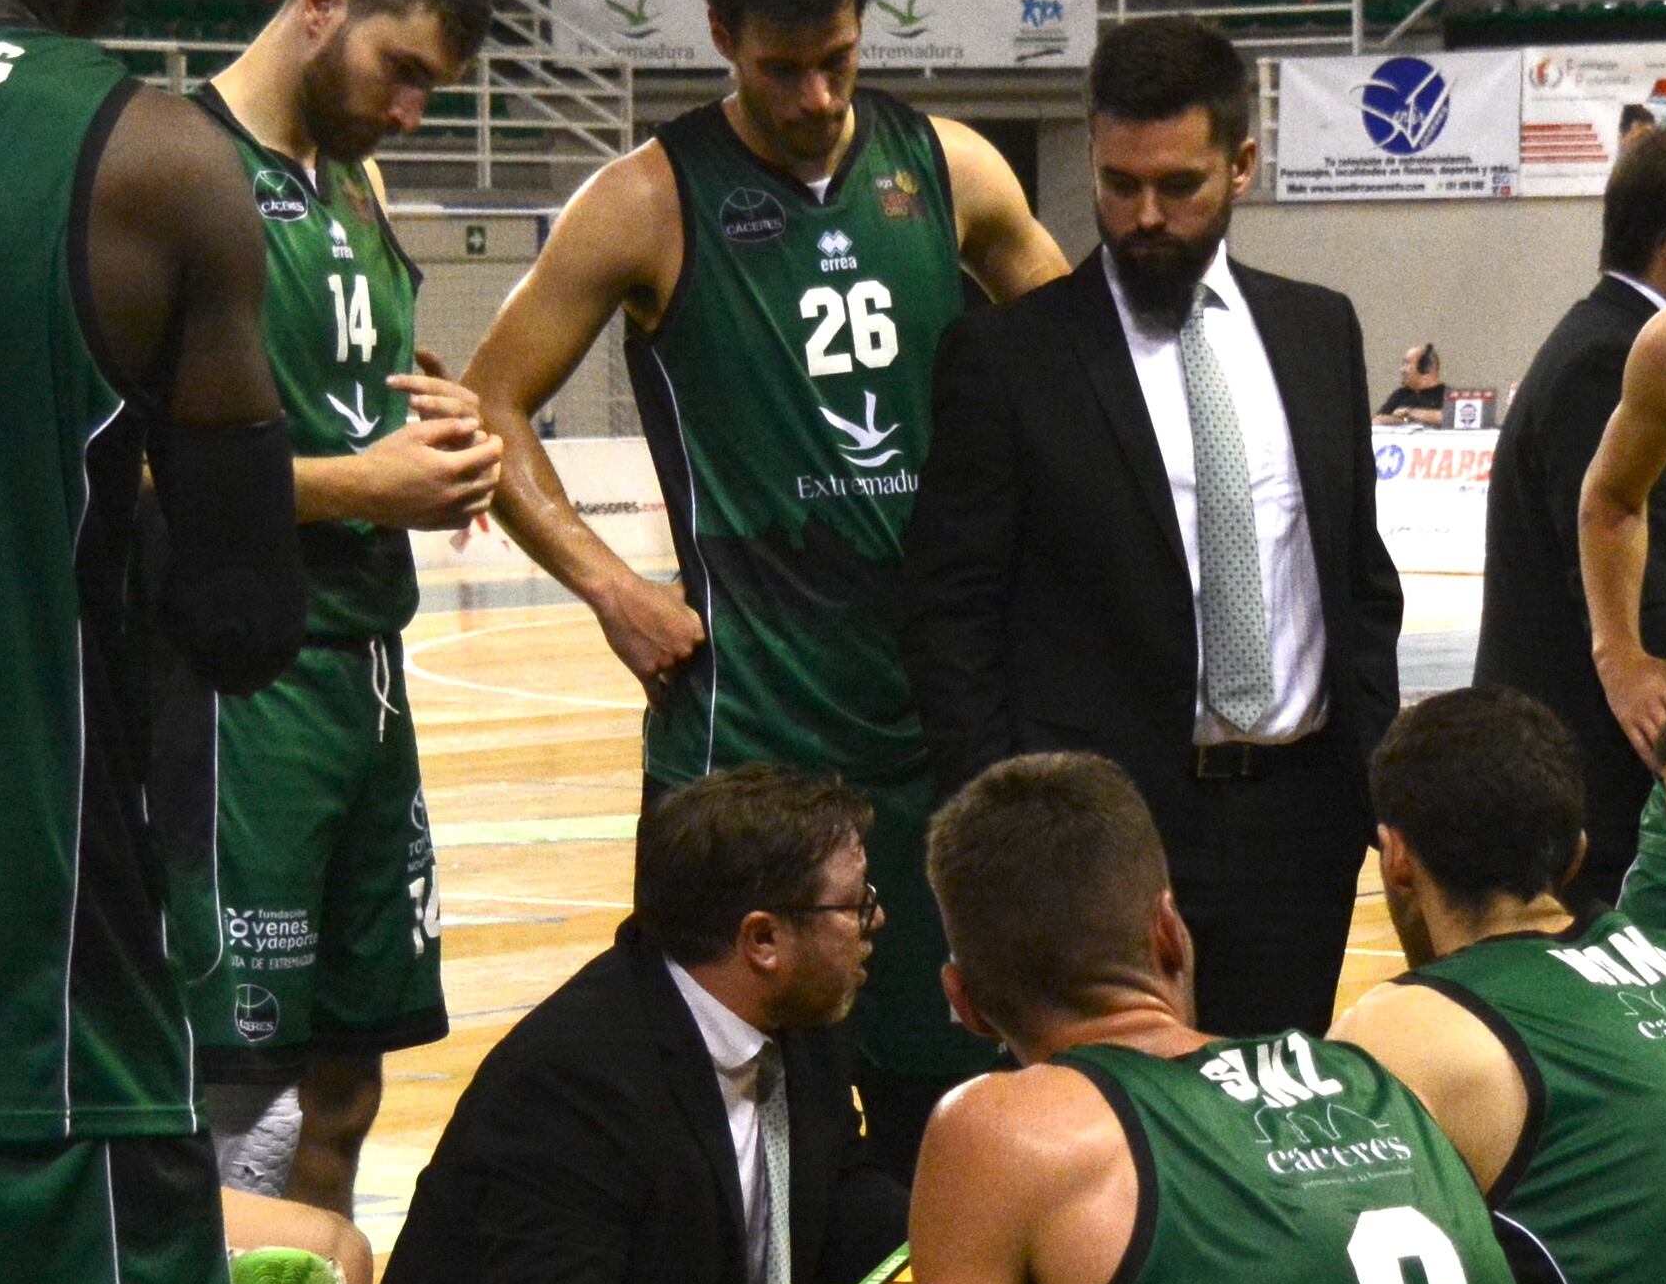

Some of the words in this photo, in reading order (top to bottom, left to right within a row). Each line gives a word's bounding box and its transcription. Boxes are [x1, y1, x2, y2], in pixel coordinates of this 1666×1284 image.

[820, 255, 858, 273] errea
[327, 273, 378, 363] 14
[800, 280, 899, 377] 26
